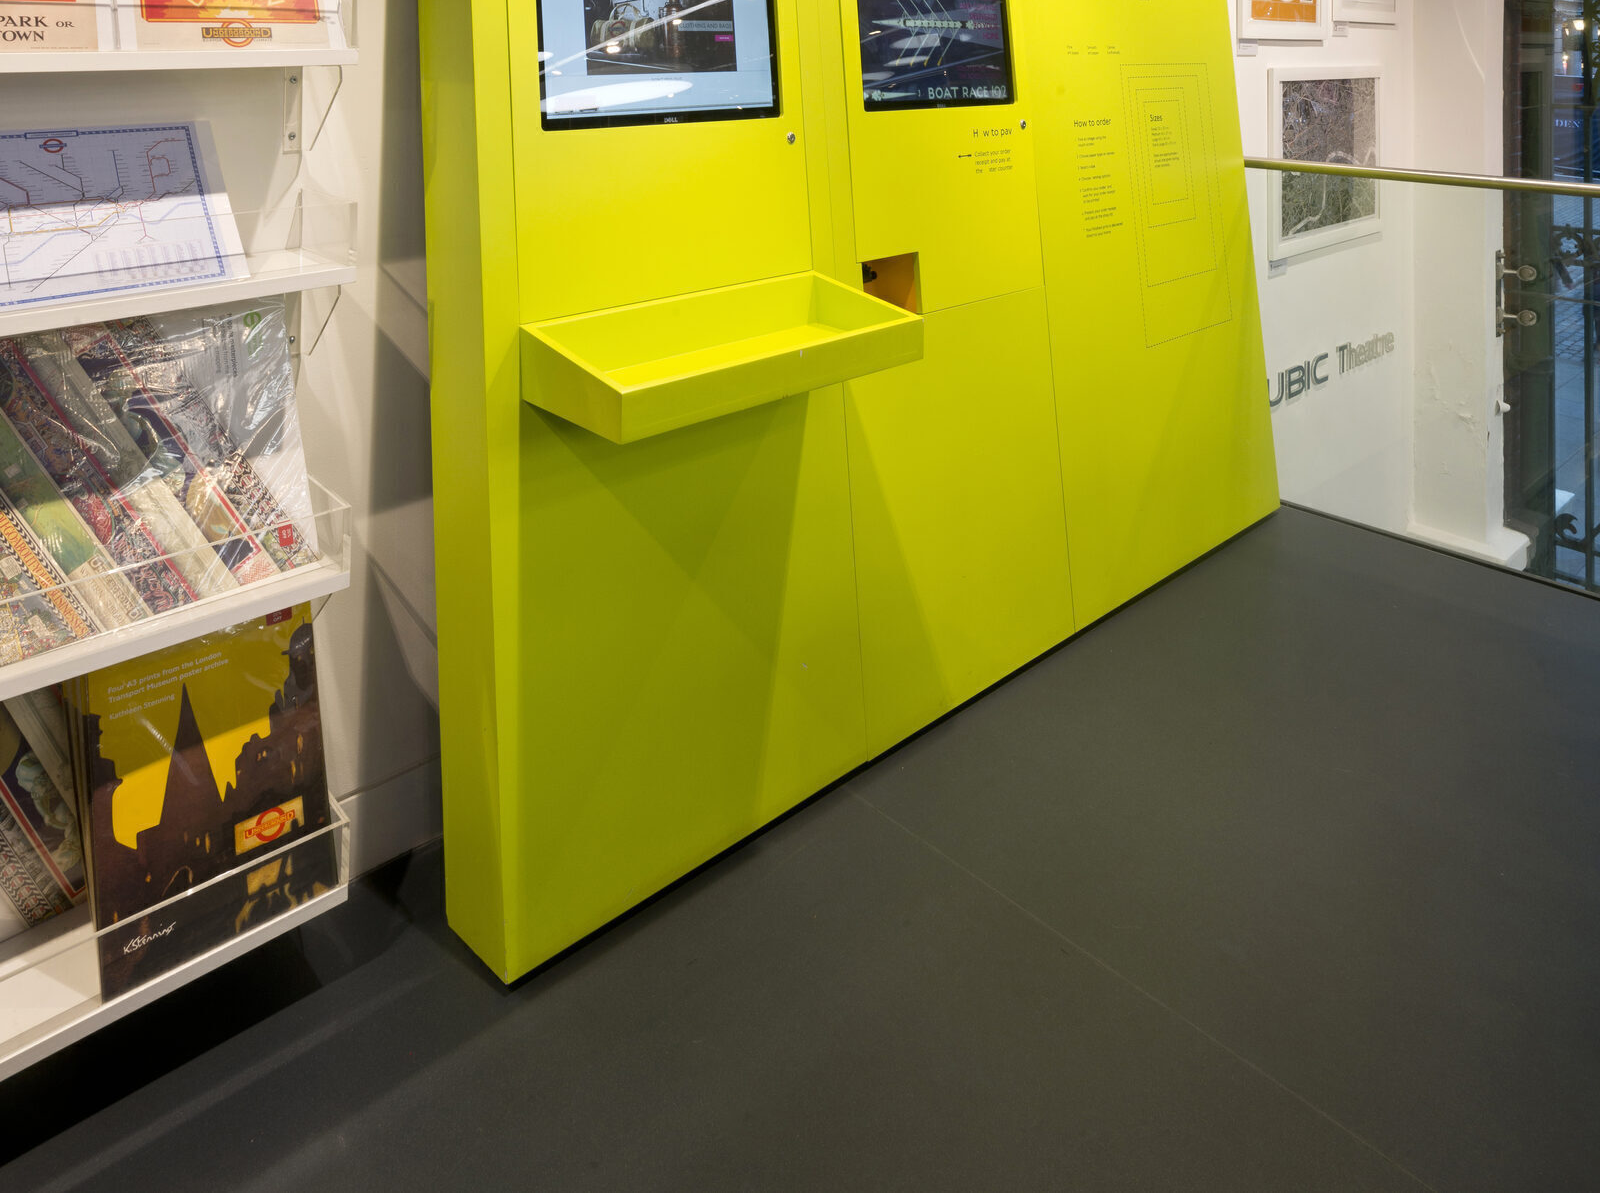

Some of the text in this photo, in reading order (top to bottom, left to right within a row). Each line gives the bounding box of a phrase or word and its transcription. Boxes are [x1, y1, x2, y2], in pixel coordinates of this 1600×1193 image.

[0, 30, 45, 42] OWN
[202, 27, 272, 38] UNDERGROUND
[927, 86, 959, 100] BOAT
[962, 86, 988, 99] RACE
[1073, 119, 1088, 128] How
[1096, 118, 1112, 126] order
[1150, 114, 1163, 122] Sizes
[973, 128, 989, 138] Hw
[991, 129, 999, 137] to
[1335, 332, 1395, 375] Theatre
[108, 651, 222, 694] Four A3 prints from the London
[109, 658, 229, 703] Transport Museum poster archive
[109, 694, 175, 720] Kathleen Stenning
